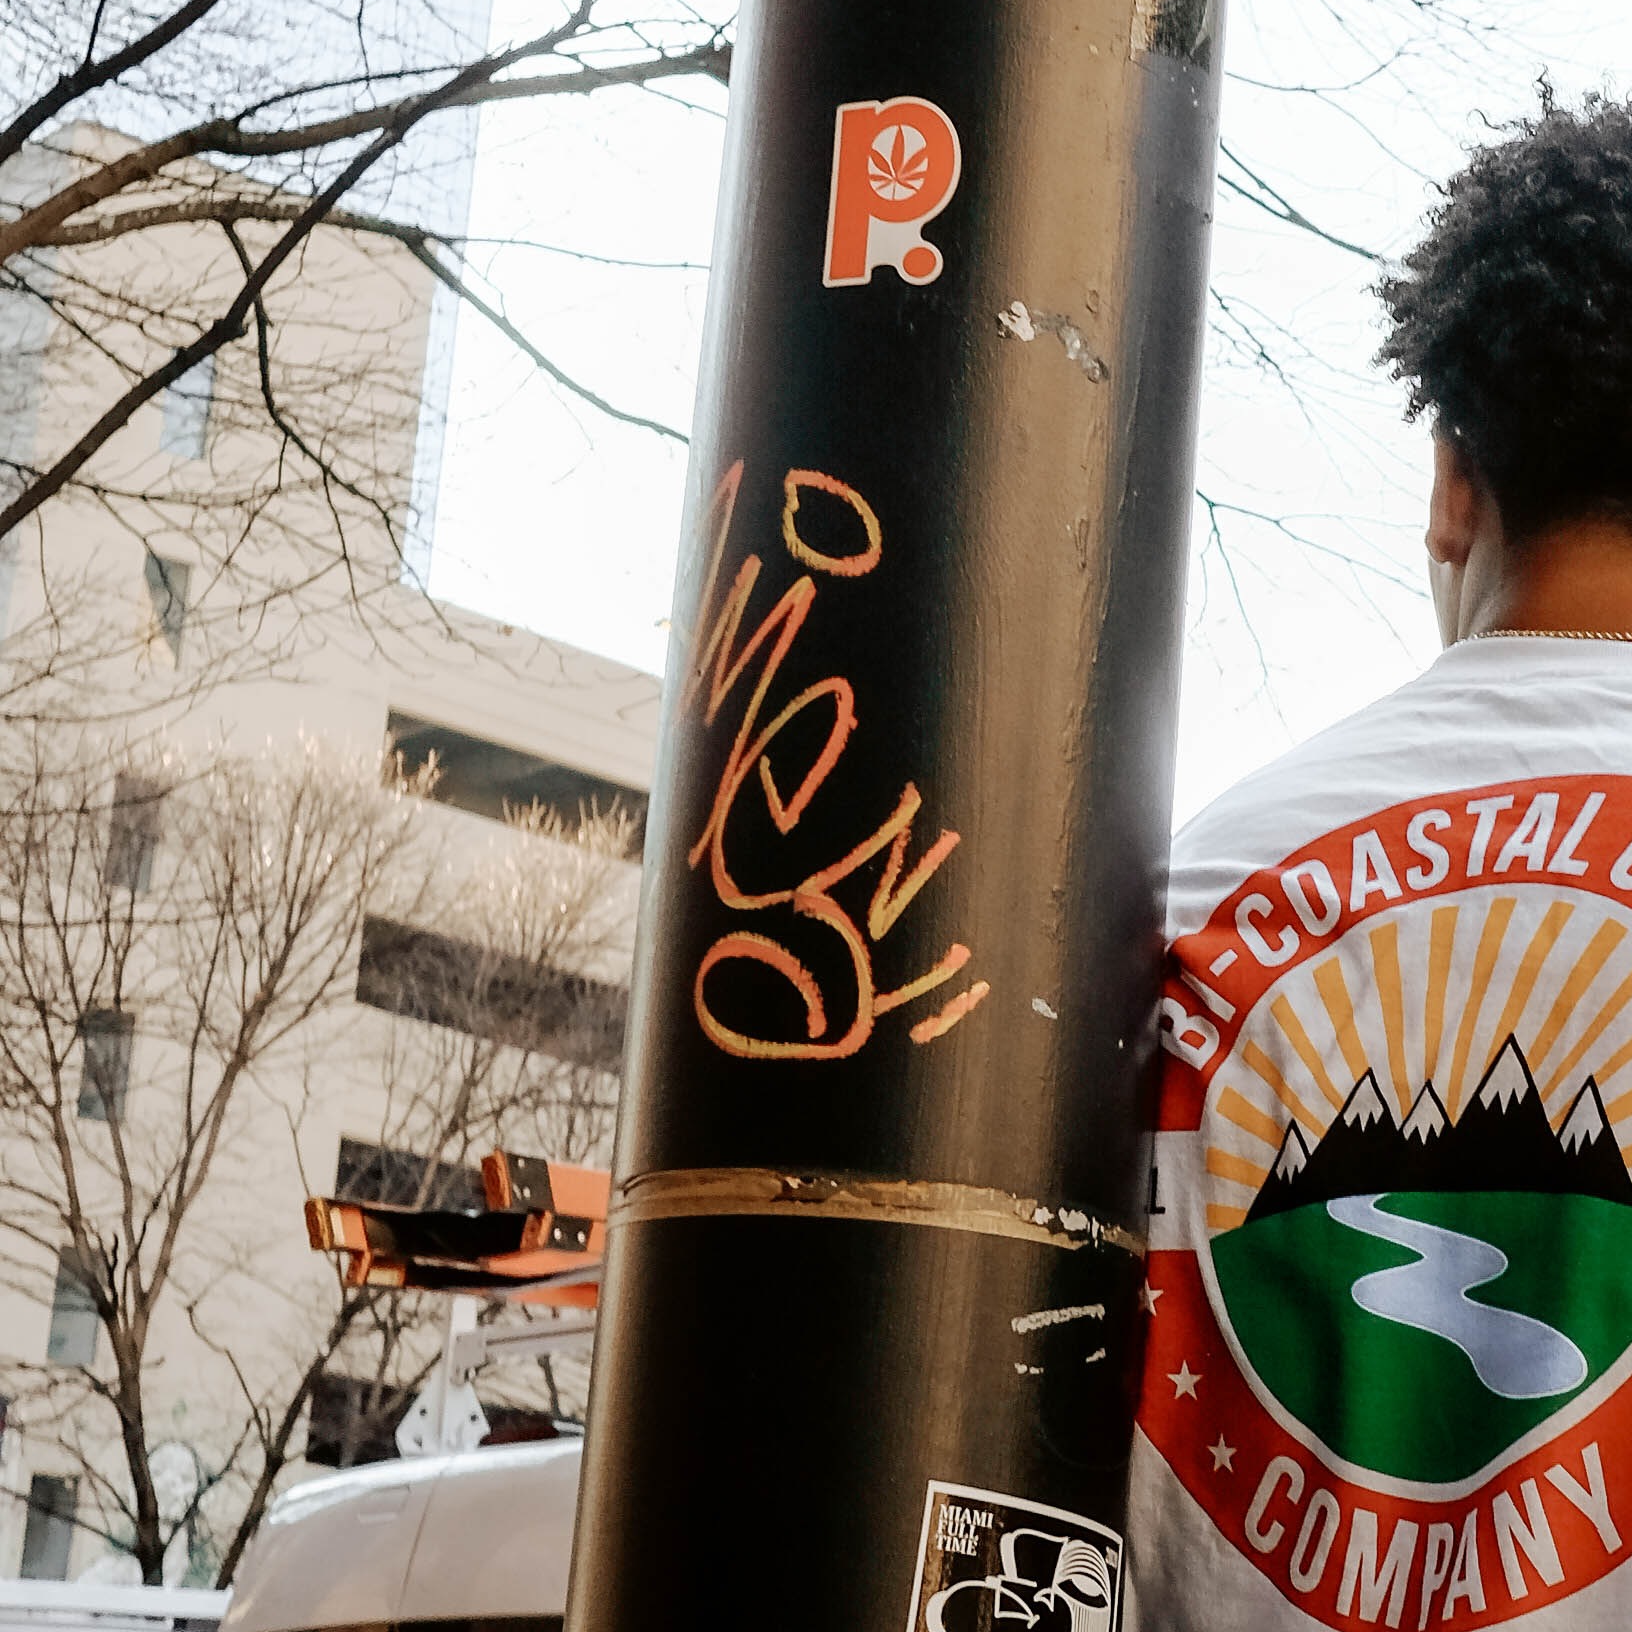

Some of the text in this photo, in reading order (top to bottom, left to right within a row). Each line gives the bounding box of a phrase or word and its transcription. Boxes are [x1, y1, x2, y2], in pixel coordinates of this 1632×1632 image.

[1155, 792, 1606, 1071] BI-COASTAL
[937, 1519, 980, 1541] FULL
[938, 1503, 994, 1530] MIAMI
[935, 1534, 979, 1557] TIME
[1244, 1442, 1624, 1632] COMPANY
